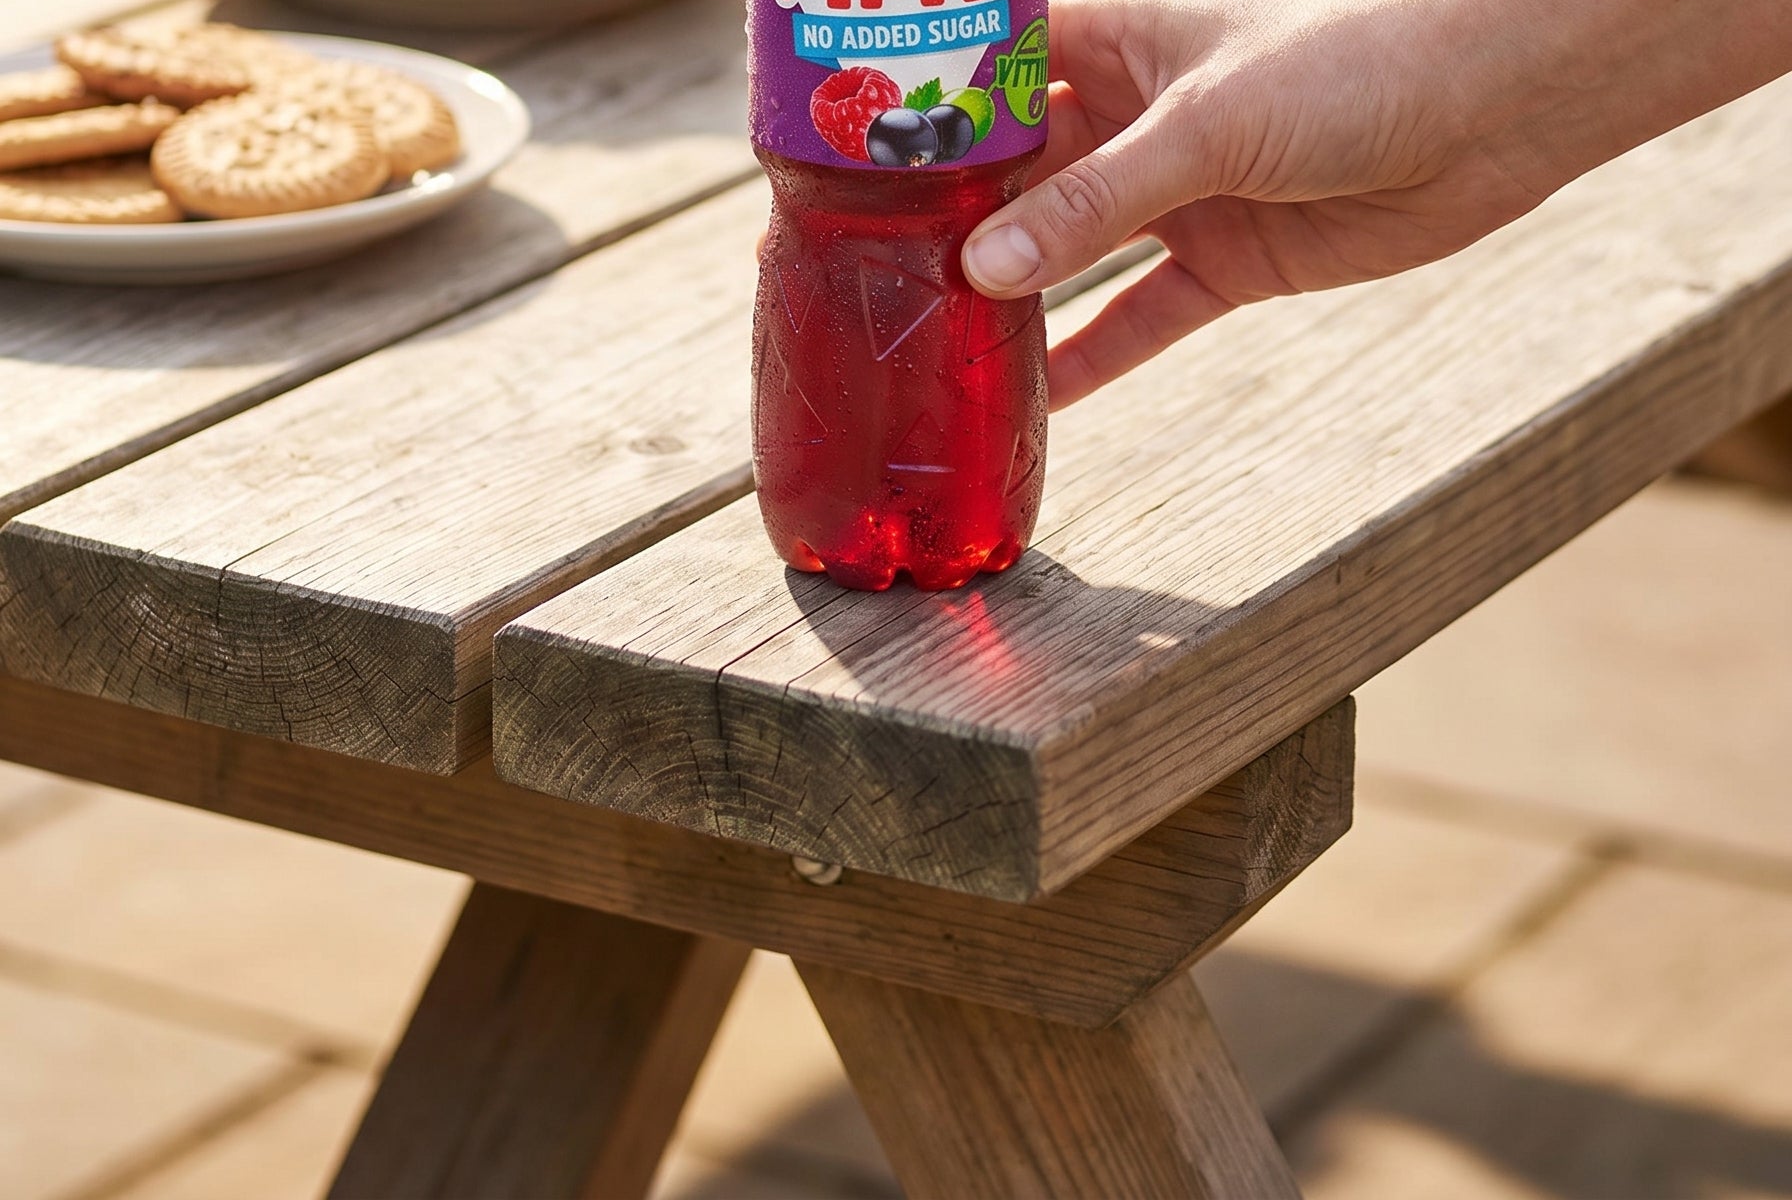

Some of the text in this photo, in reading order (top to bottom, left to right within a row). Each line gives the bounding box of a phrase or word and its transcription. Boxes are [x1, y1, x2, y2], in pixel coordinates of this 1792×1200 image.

[803, 9, 1001, 49] NO ADDED SUGAR
